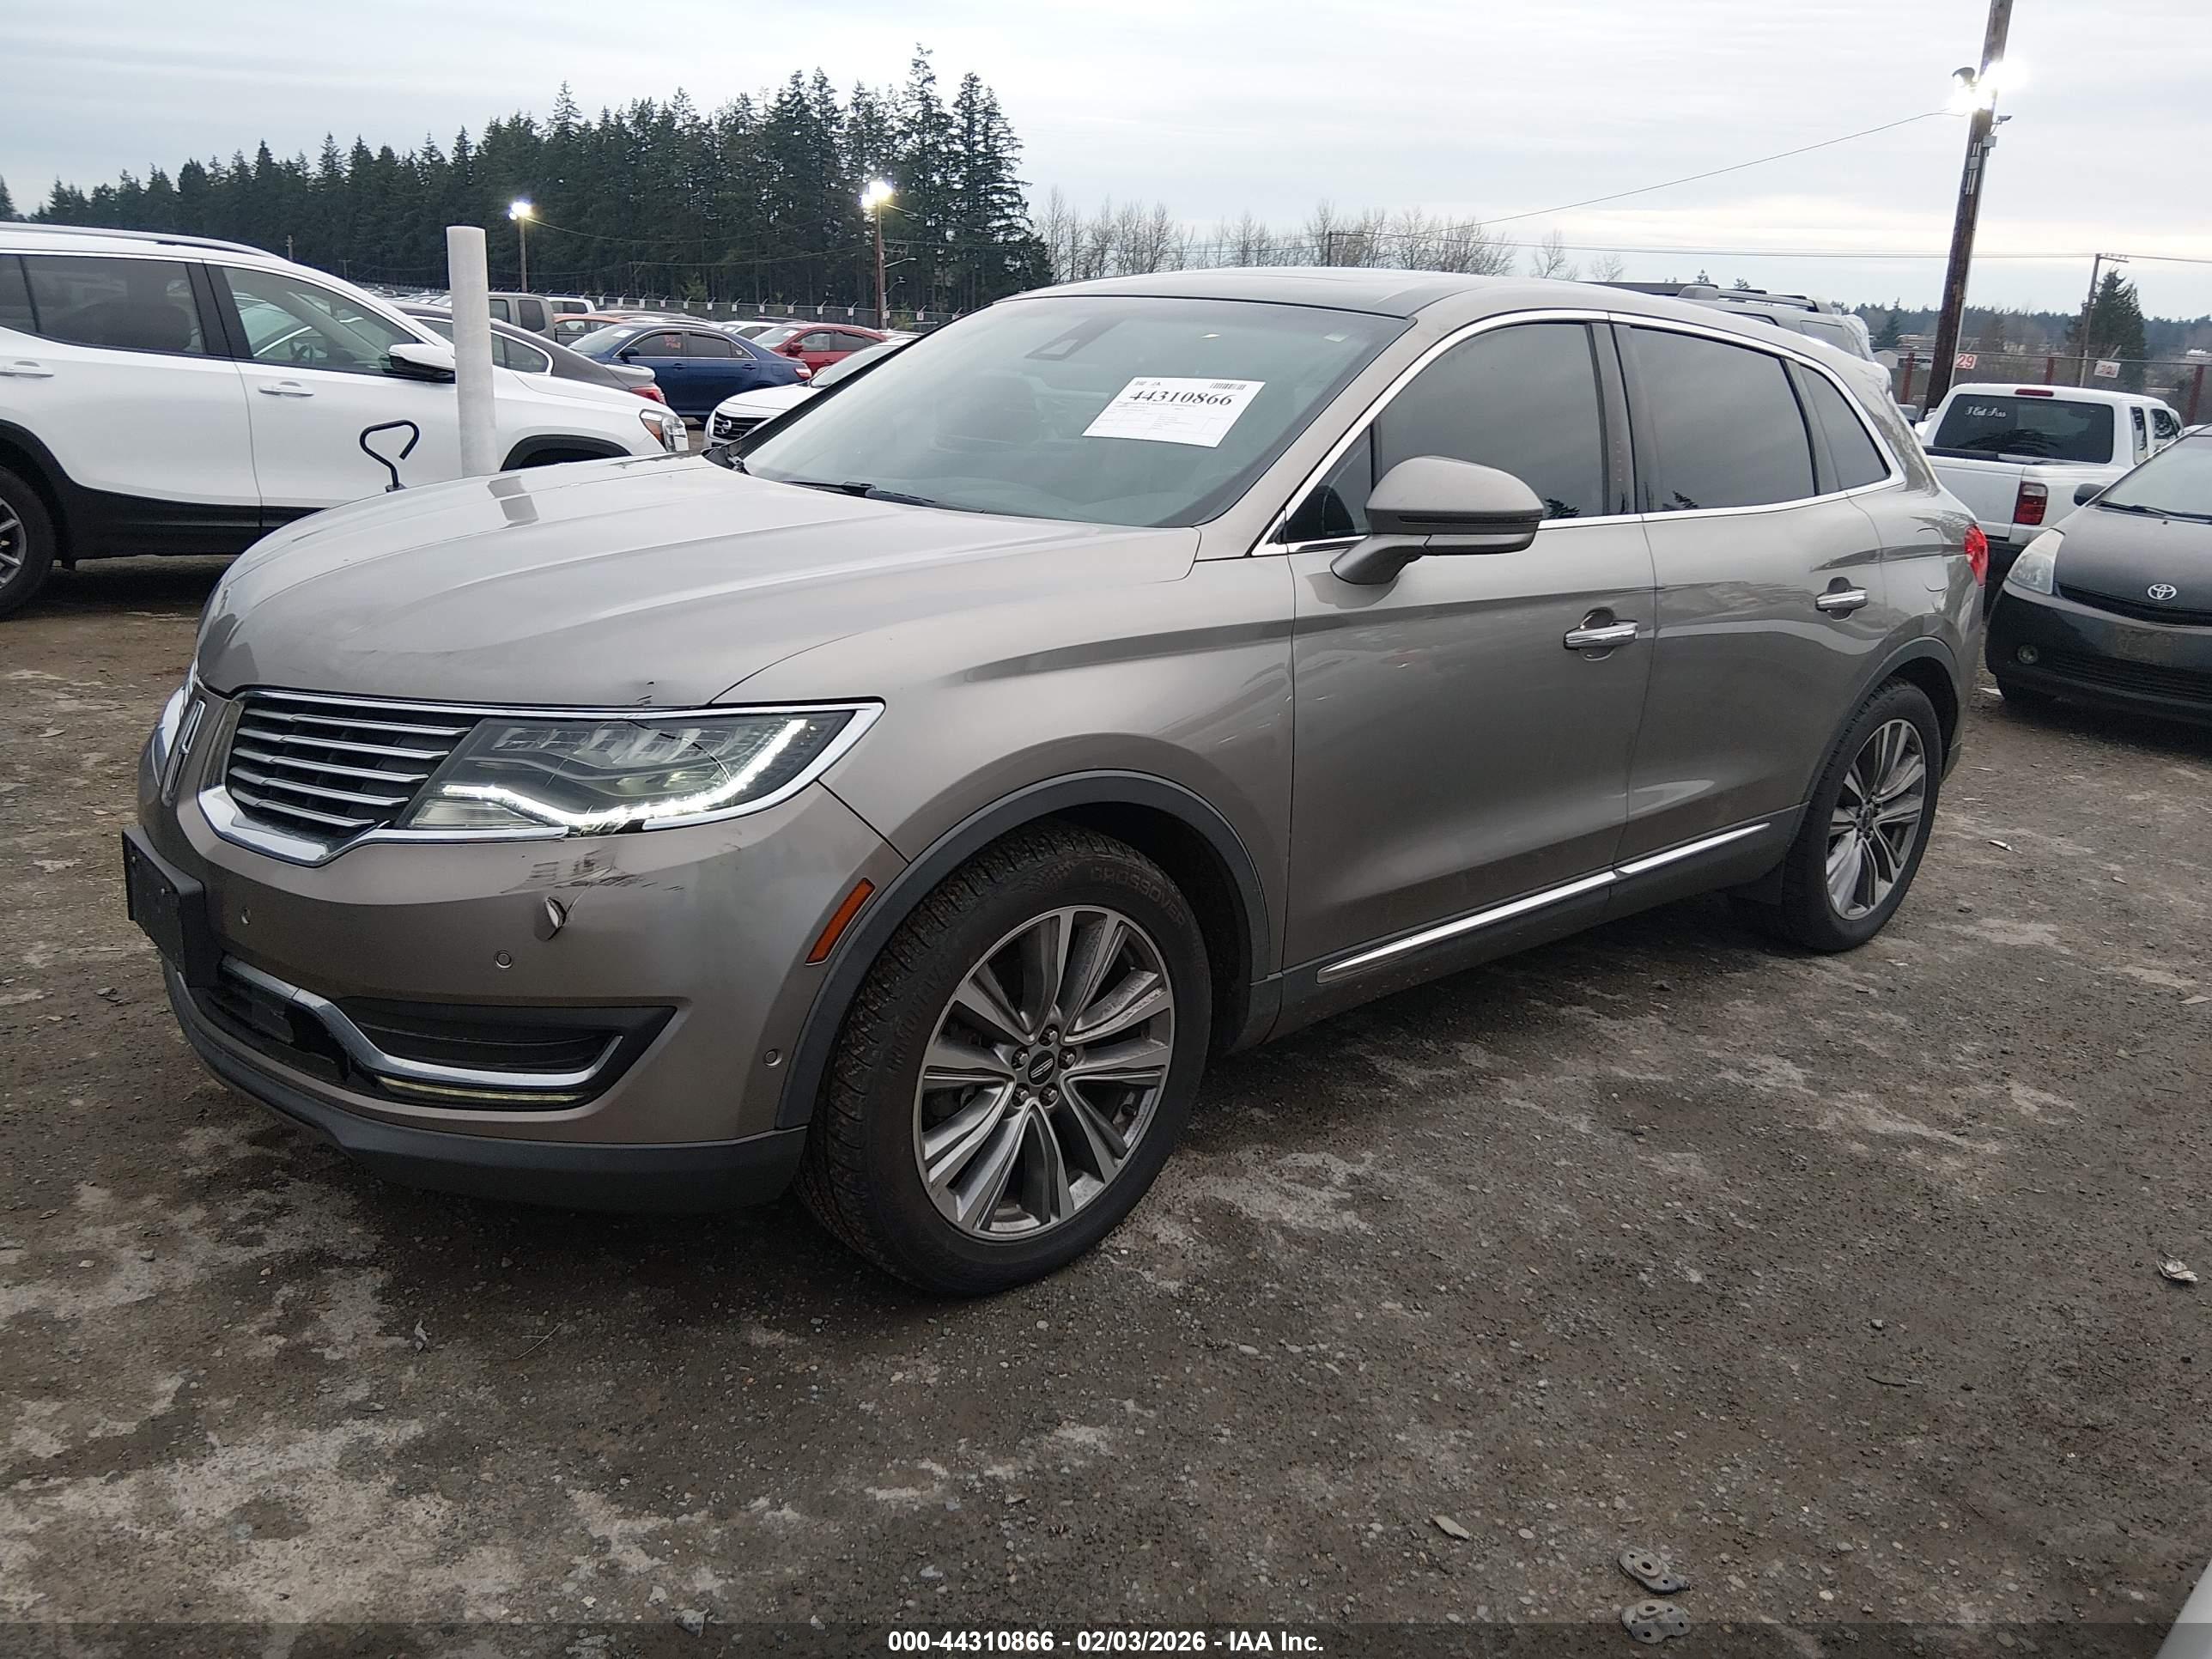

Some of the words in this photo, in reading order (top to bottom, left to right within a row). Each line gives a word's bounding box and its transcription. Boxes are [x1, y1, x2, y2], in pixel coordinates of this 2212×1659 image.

[1956, 354, 1975, 368] 29
[1129, 390, 1237, 406] 44310866
[1090, 865, 1187, 929] CROSSOVER
